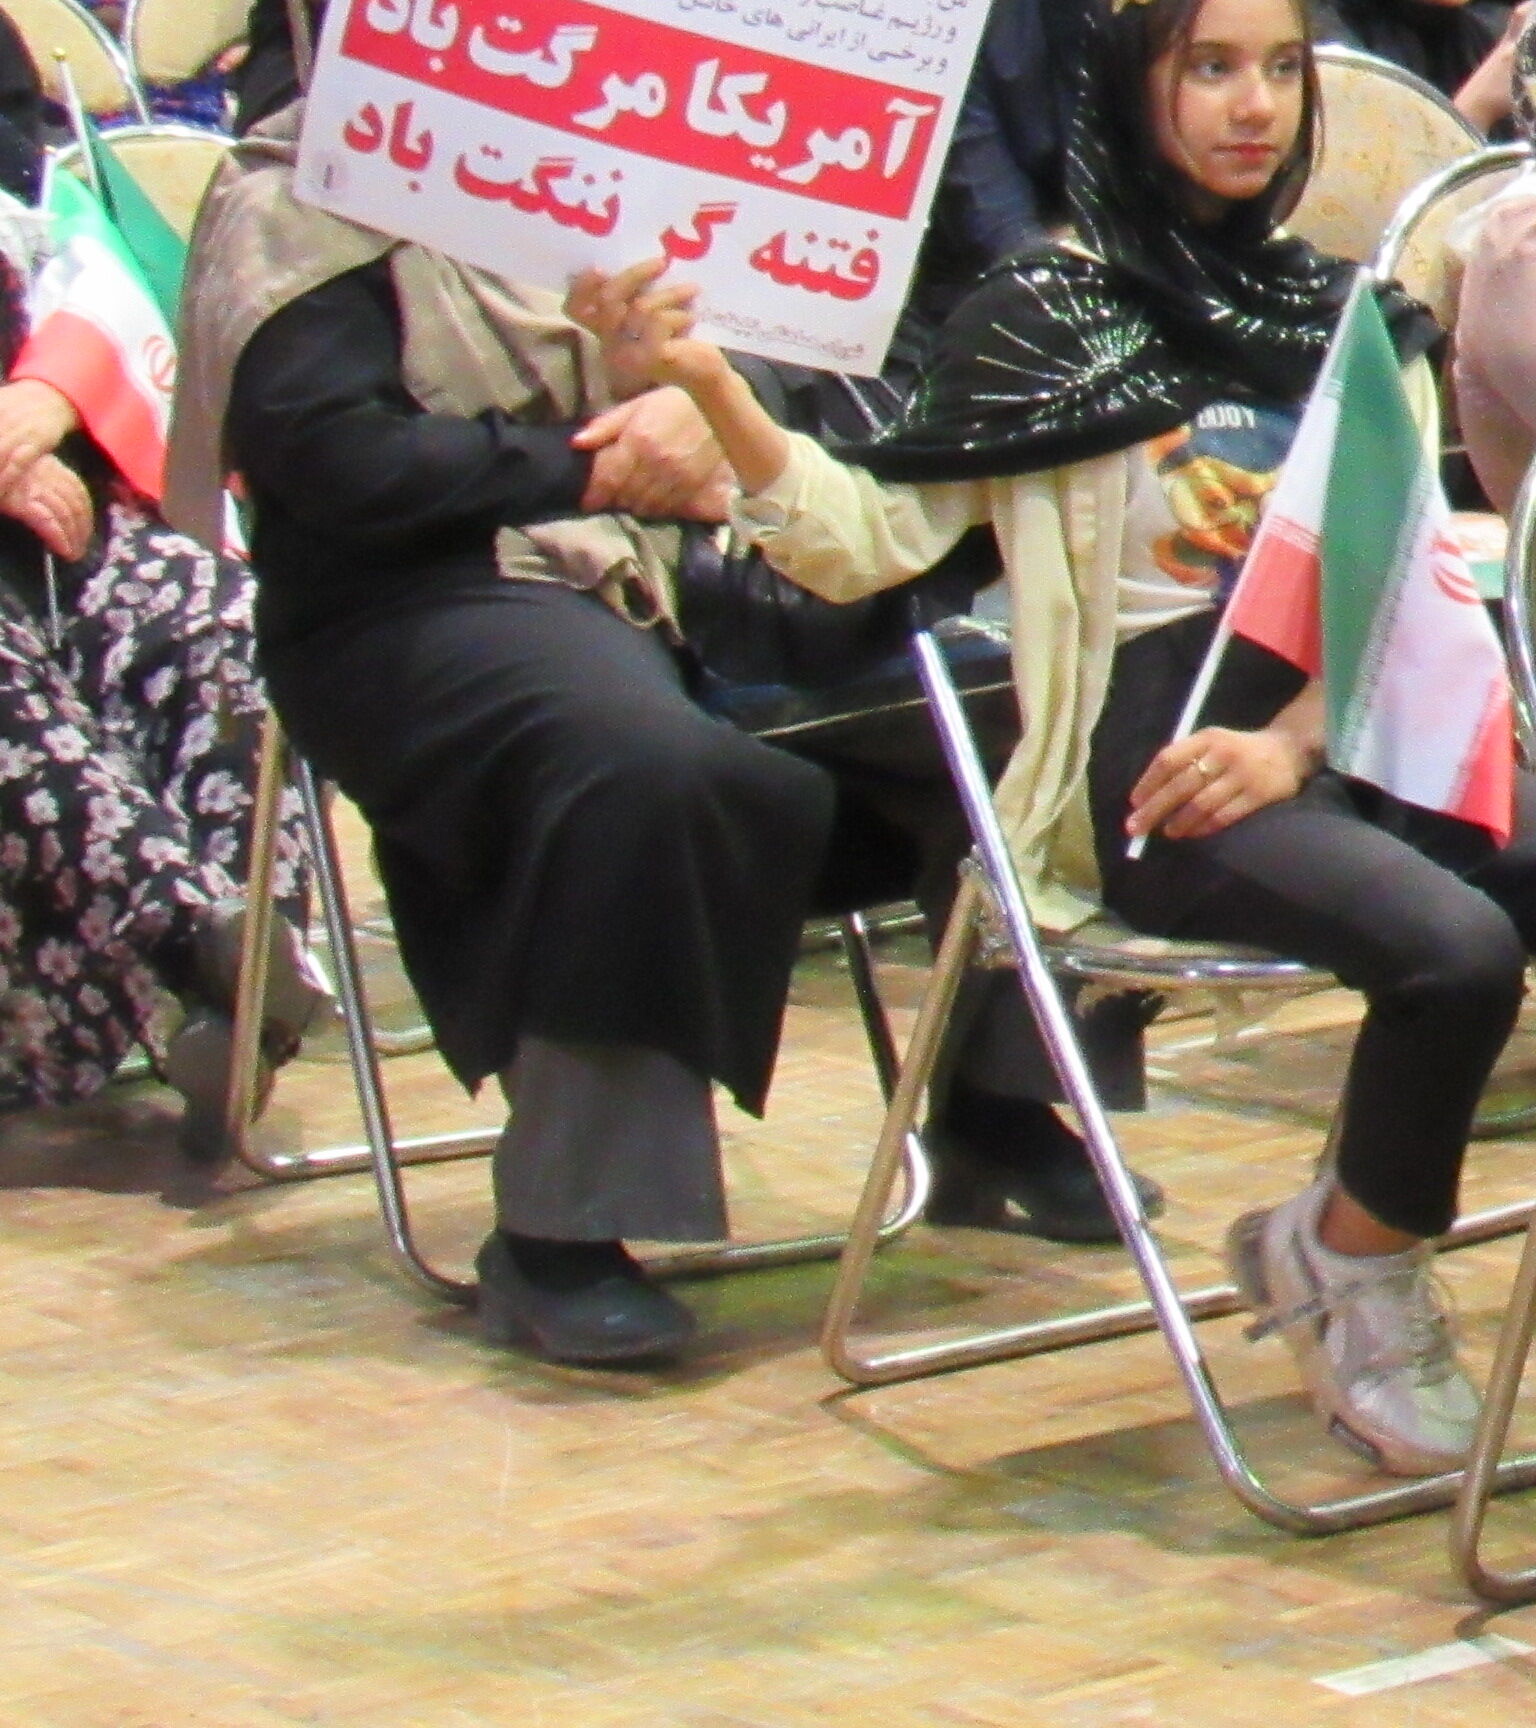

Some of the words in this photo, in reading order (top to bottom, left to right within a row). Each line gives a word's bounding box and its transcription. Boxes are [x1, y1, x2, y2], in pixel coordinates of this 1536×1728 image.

[467, 14, 667, 130] مرگت
[847, 33, 866, 52] از
[867, 44, 933, 73] برخی
[936, 56, 948, 73] و
[943, 26, 956, 44] و
[343, 101, 433, 193] باد
[684, 58, 935, 183] آمریکا
[453, 143, 624, 238] ننگت
[748, 226, 881, 301] فتنه
